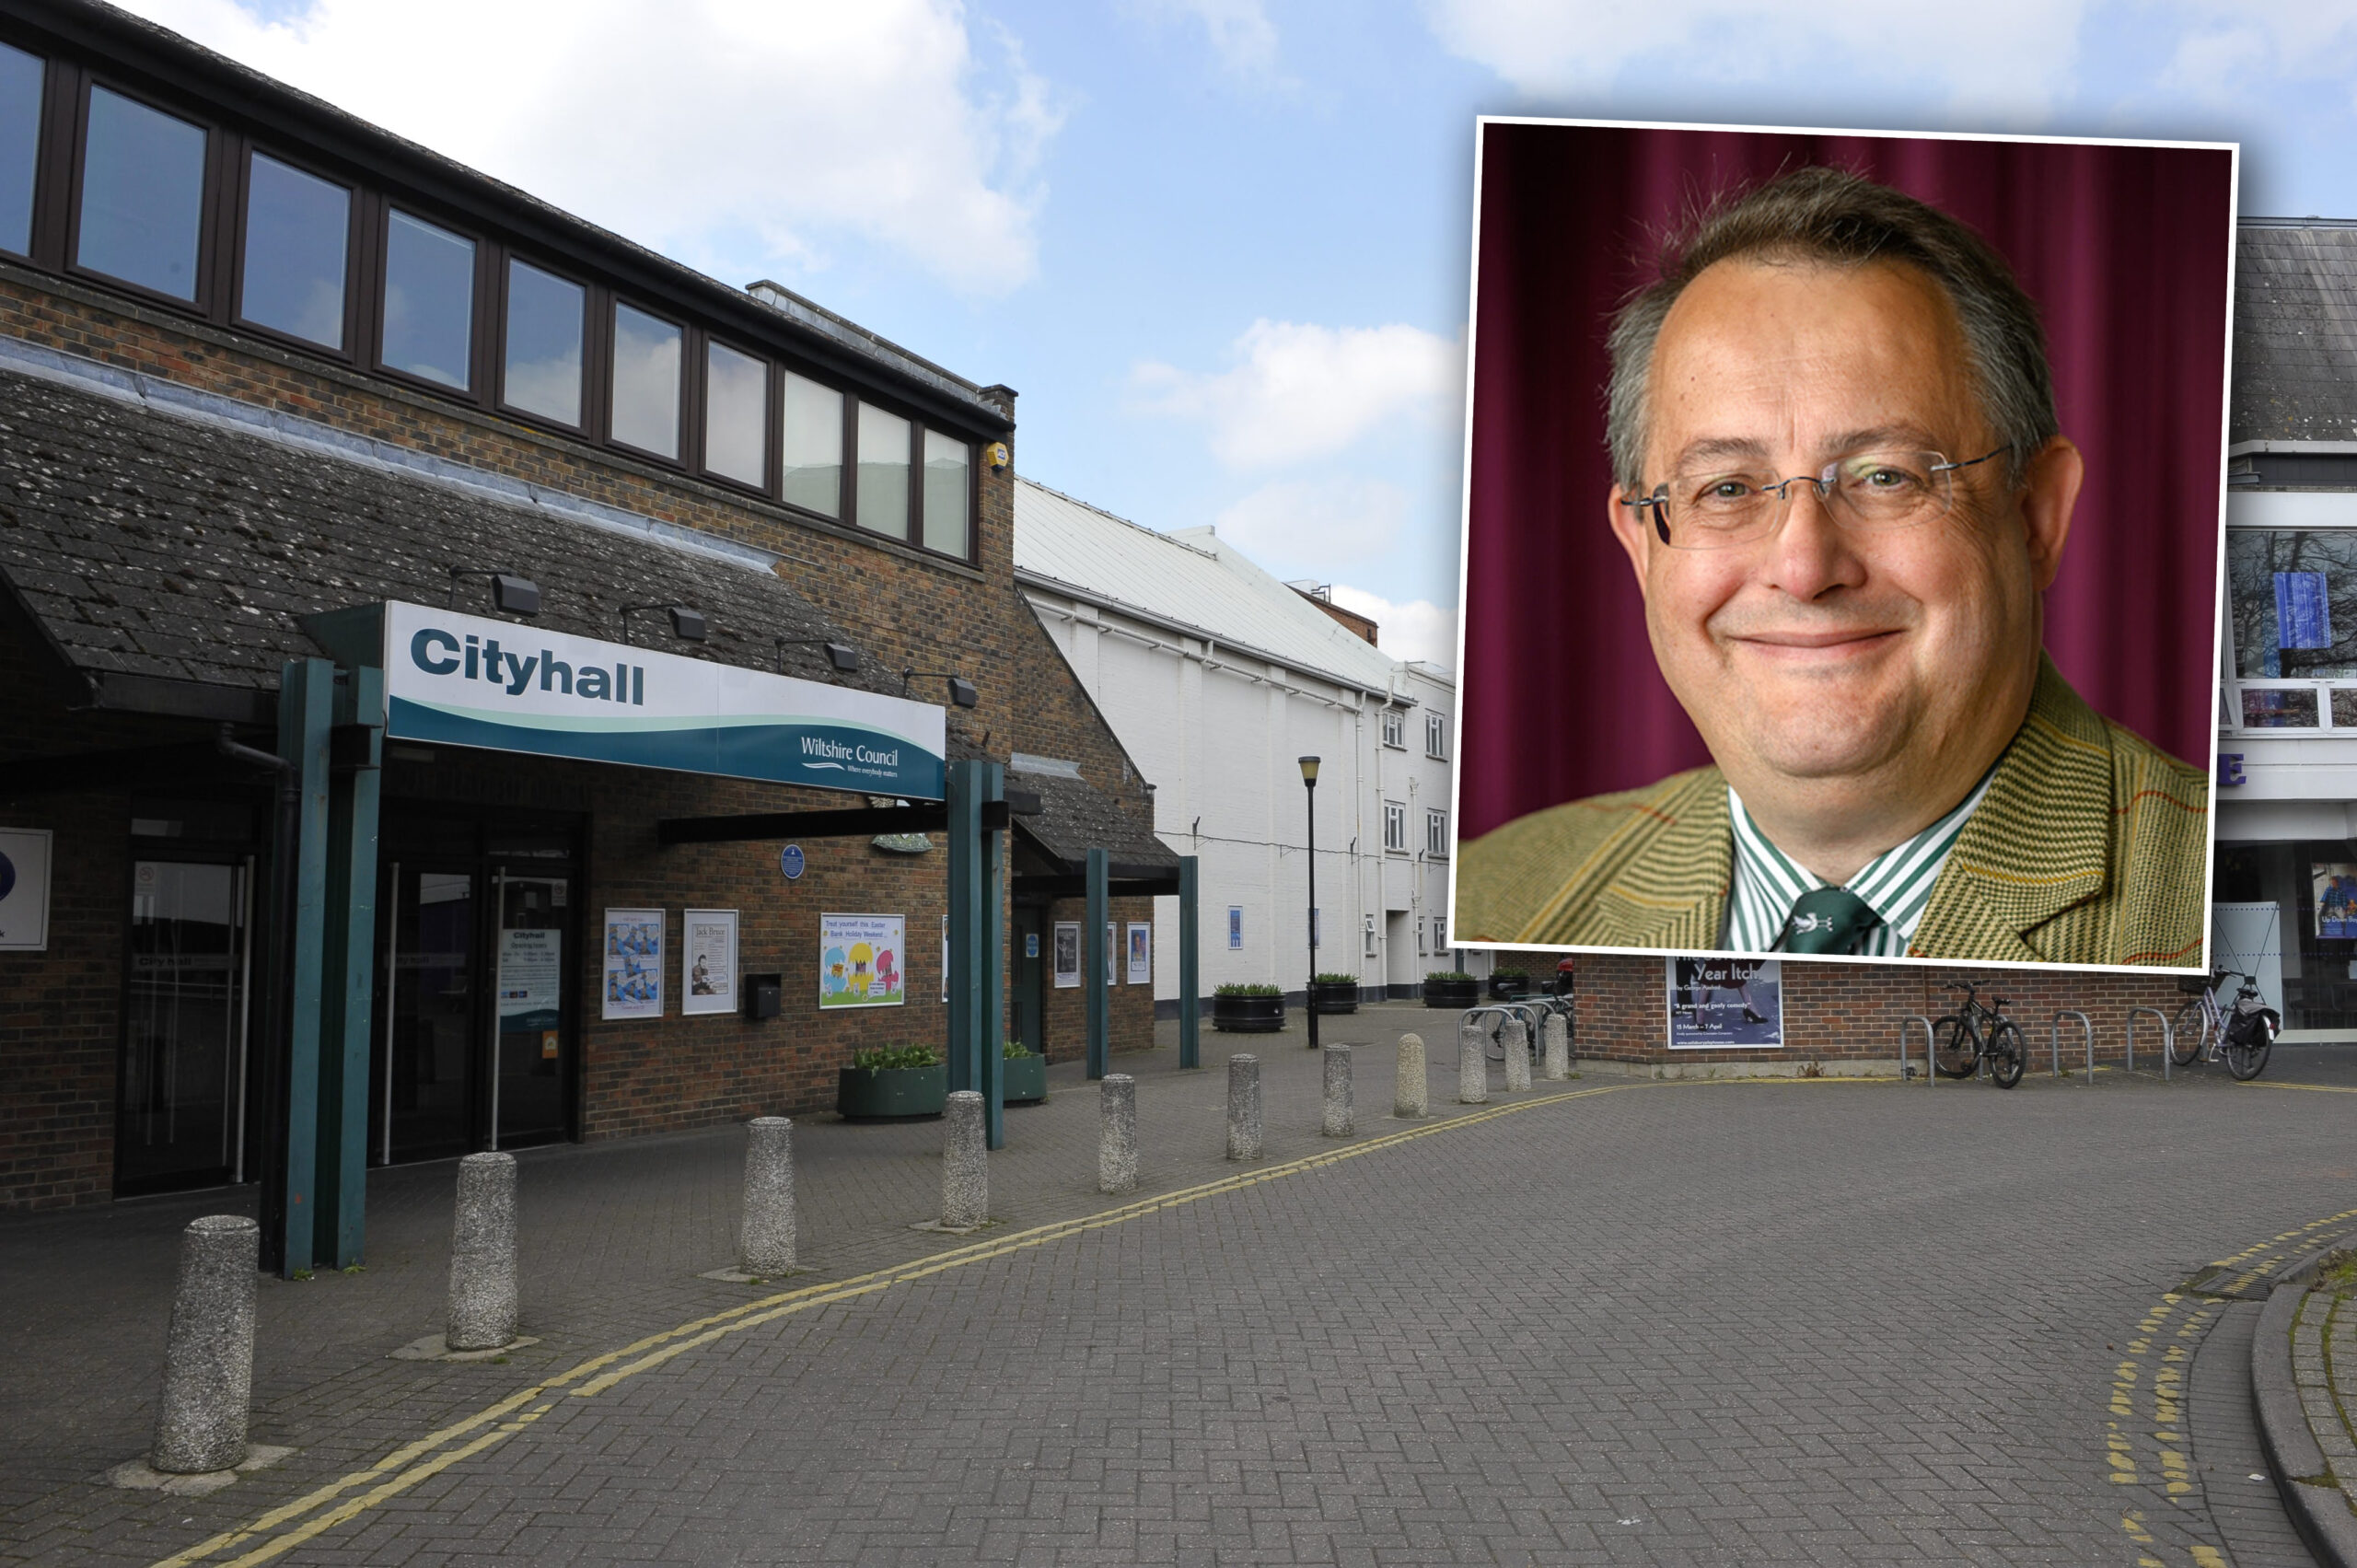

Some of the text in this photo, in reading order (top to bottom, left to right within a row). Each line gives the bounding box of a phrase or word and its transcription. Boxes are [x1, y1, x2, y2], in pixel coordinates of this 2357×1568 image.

[411, 629, 644, 705] Cityhall
[801, 737, 898, 766] Wiltshire Council
[847, 765, 862, 773] Where
[862, 768, 882, 778] everybody
[696, 927, 708, 936] Jack
[1694, 963, 1757, 980] Year Itch
